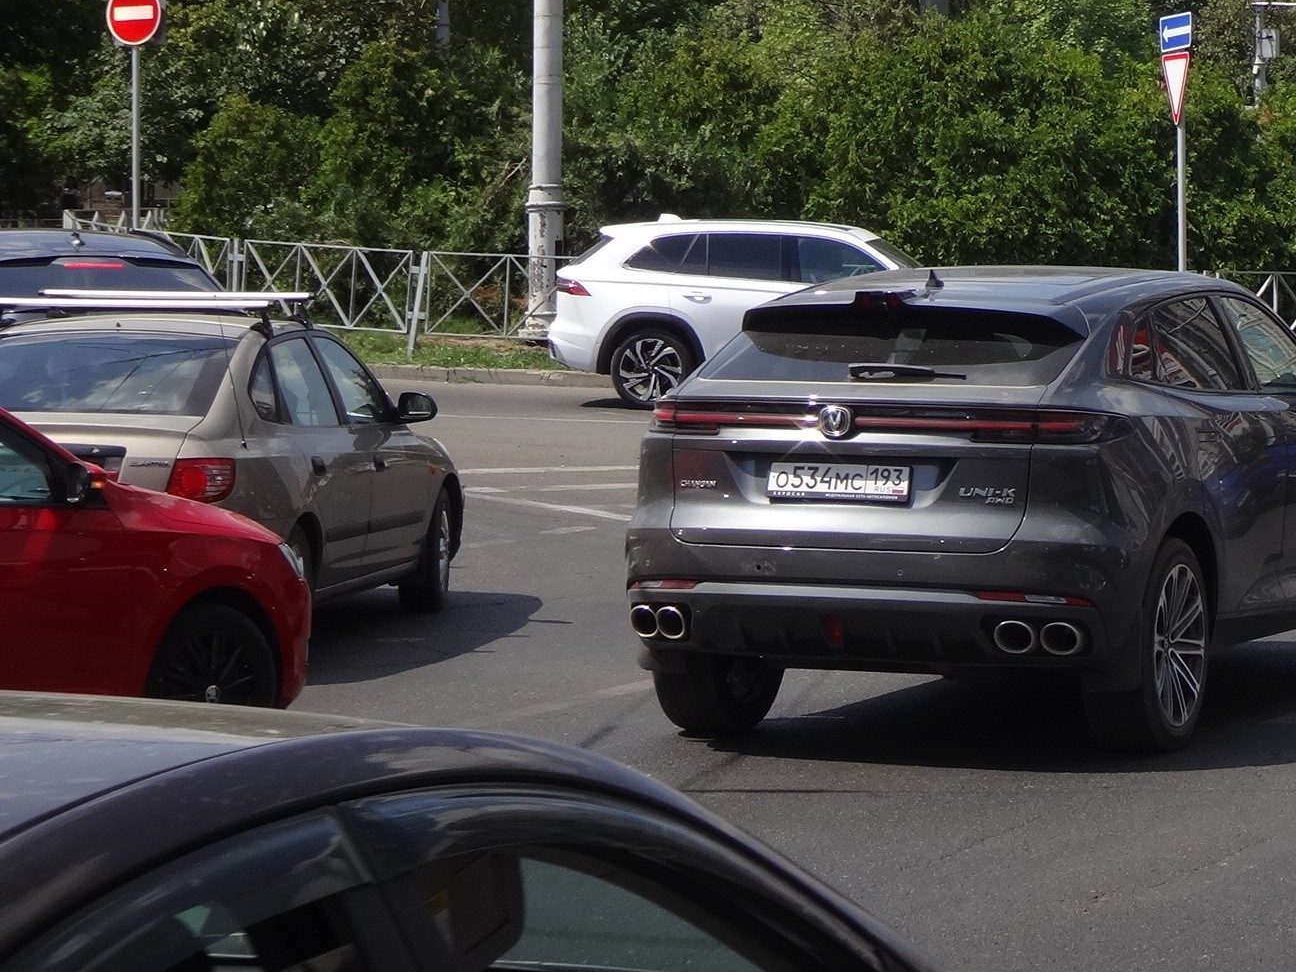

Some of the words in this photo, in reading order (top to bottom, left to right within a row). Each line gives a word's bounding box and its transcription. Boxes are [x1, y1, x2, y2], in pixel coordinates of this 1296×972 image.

[775, 465, 864, 491] О534МС
[869, 466, 904, 487] 193
[959, 487, 1016, 497] UNI-K
